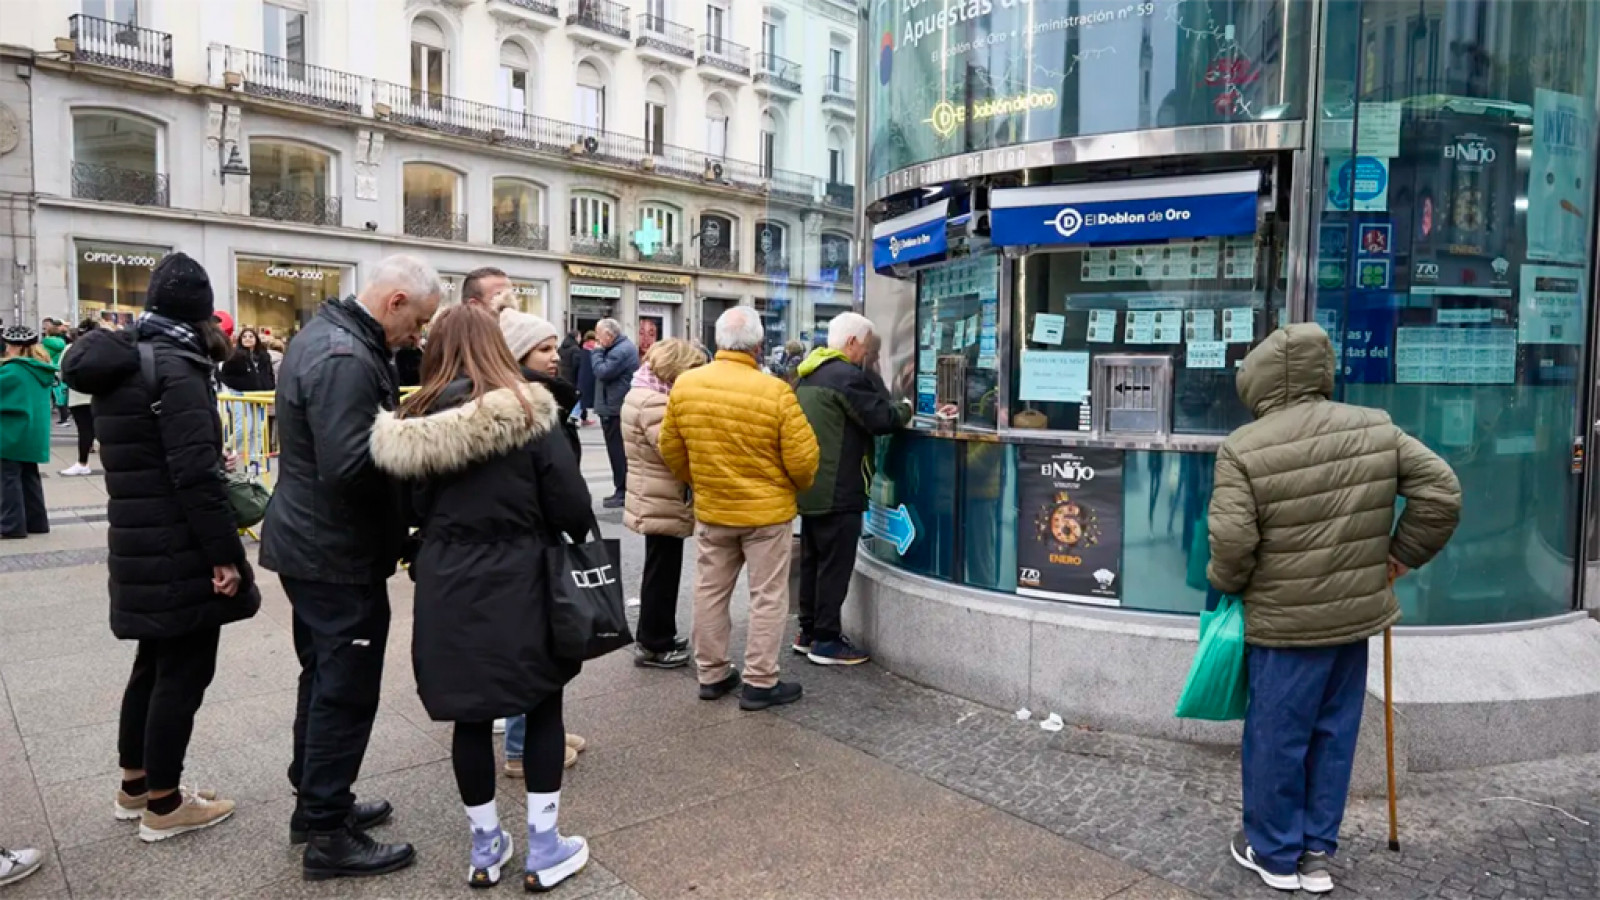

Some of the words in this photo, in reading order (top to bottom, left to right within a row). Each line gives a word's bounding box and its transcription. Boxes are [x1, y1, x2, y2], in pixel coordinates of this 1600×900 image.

[902, 0, 992, 48] Apuestas
[986, 31, 1007, 44] Oro
[1137, 2, 1154, 16] 59
[1028, 93, 1054, 108] Oro
[1456, 141, 1496, 164] Niño
[1085, 213, 1097, 226] El
[1098, 211, 1145, 225] Doblon
[1148, 211, 1163, 222] de
[1165, 207, 1190, 221] Oro
[84, 250, 126, 265] OPTICA
[127, 254, 156, 267] 2000
[265, 265, 299, 279] OPTICA
[301, 270, 323, 281] 2000
[1416, 263, 1439, 274] 770
[1369, 346, 1388, 358] del
[1053, 460, 1095, 482] Niño
[1051, 502, 1082, 545] 6
[1049, 553, 1082, 566] ENERO
